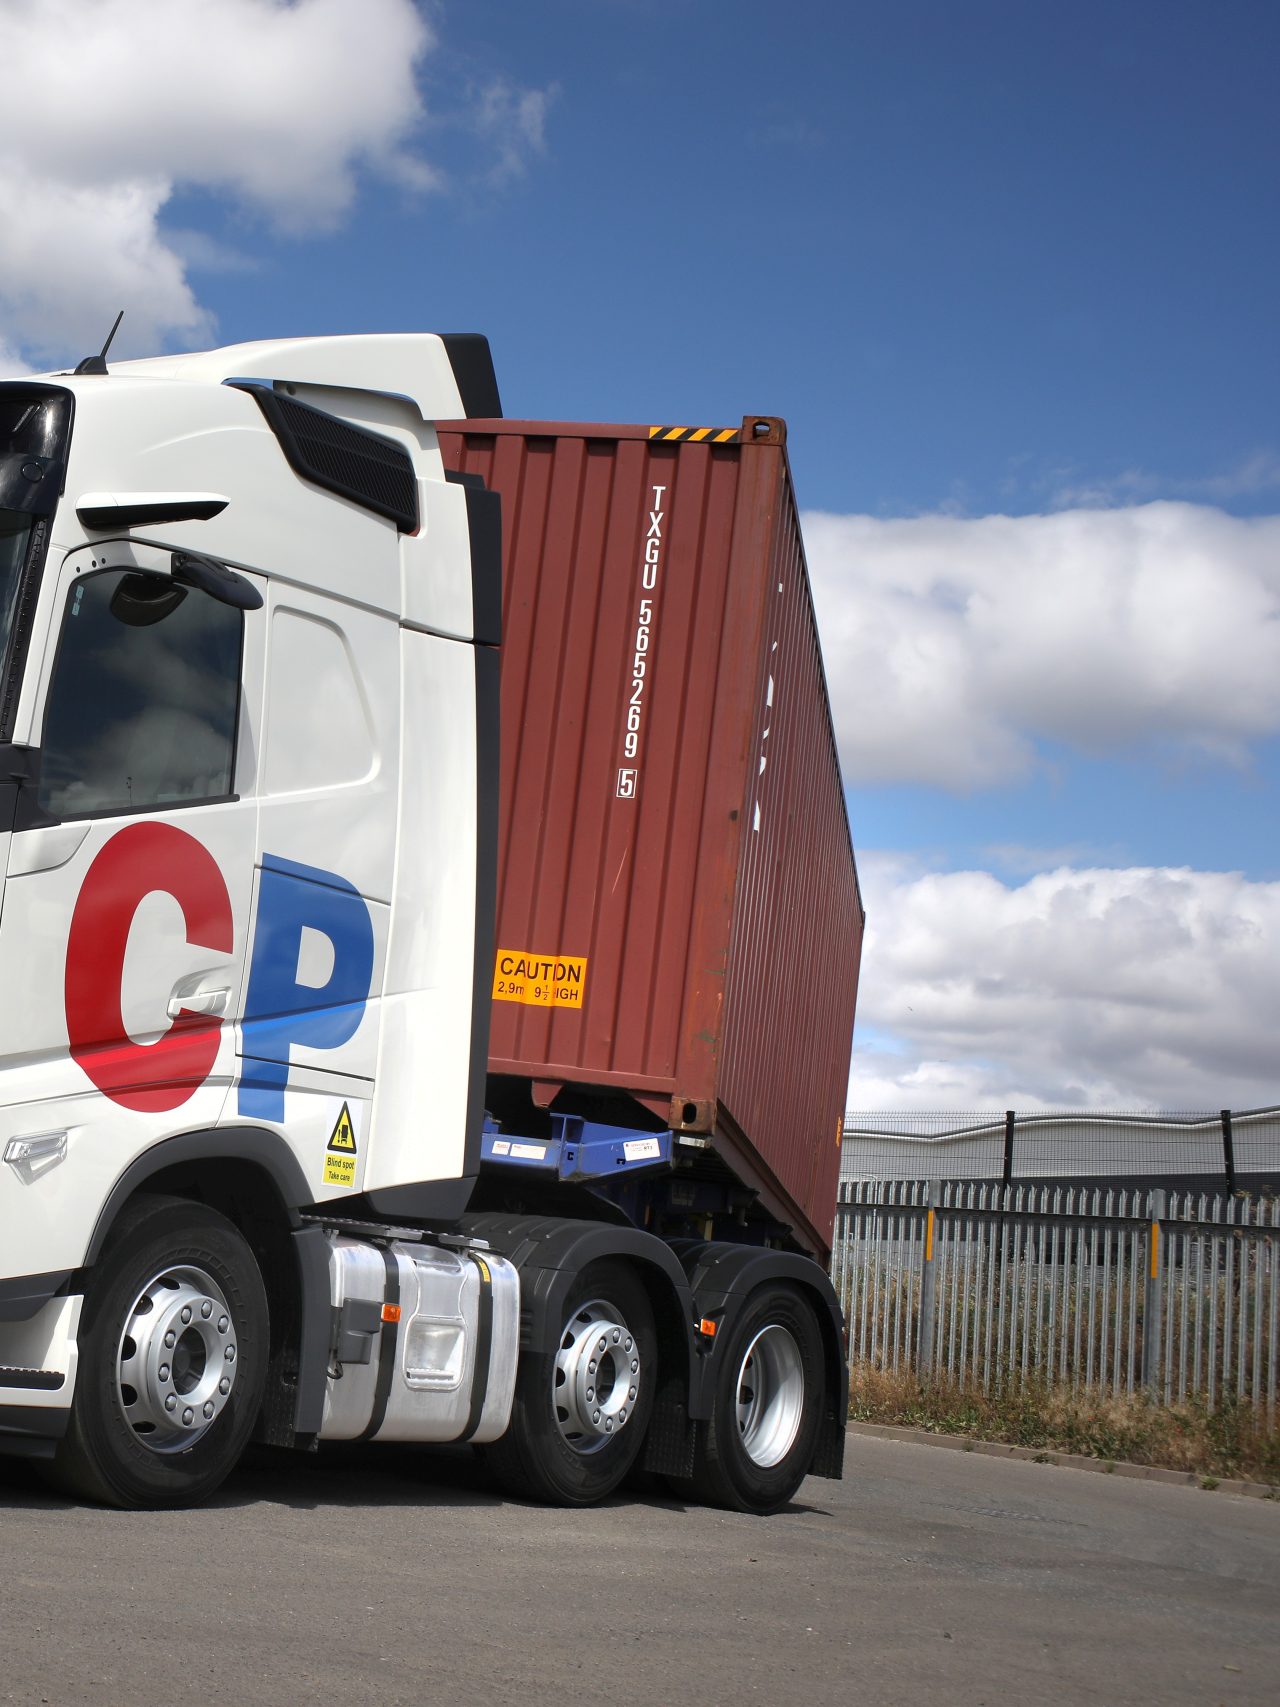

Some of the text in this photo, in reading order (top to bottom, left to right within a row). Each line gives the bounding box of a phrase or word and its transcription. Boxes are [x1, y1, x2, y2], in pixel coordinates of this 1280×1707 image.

[619, 486, 666, 798] TXGU 565269 5
[65, 821, 374, 1123] CP
[555, 987, 578, 1000] IGH
[327, 1156, 355, 1170] Blind spot
[328, 1170, 351, 1182] Take care
